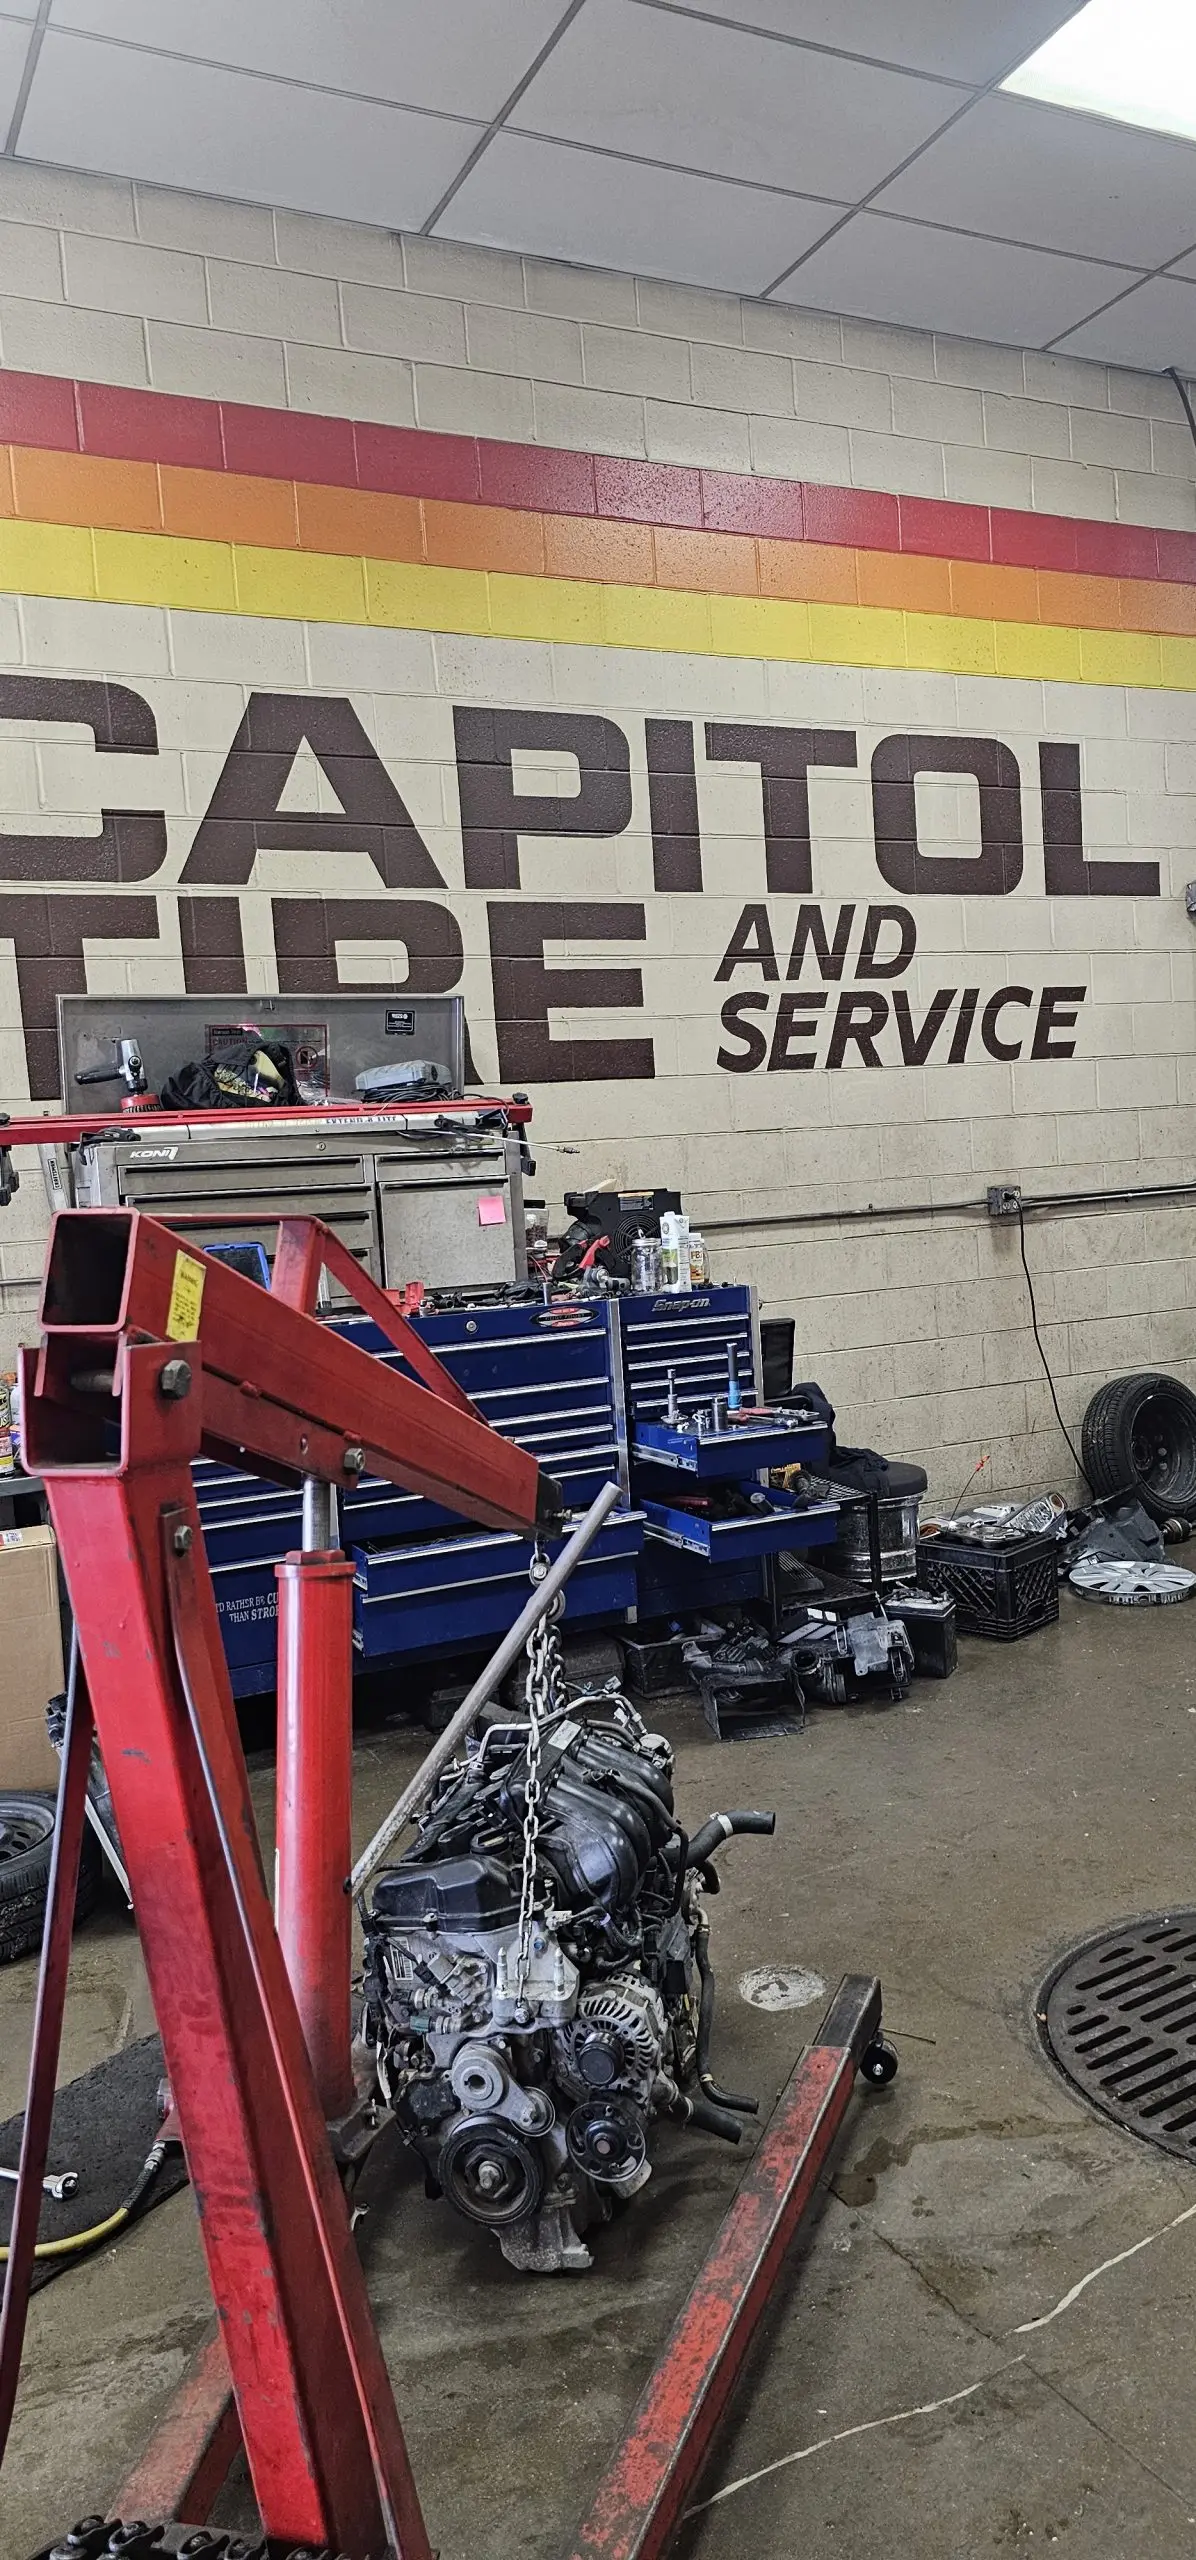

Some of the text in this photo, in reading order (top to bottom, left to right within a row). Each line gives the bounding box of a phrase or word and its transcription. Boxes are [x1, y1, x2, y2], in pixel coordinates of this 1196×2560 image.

[0, 674, 1161, 896] CAPITOL
[713, 903, 917, 983] AND
[716, 985, 1087, 1073] SERVICE
[129, 1146, 179, 1161] KONI
[652, 1297, 711, 1313] Snap-on
[229, 1610, 249, 1623] THAN
